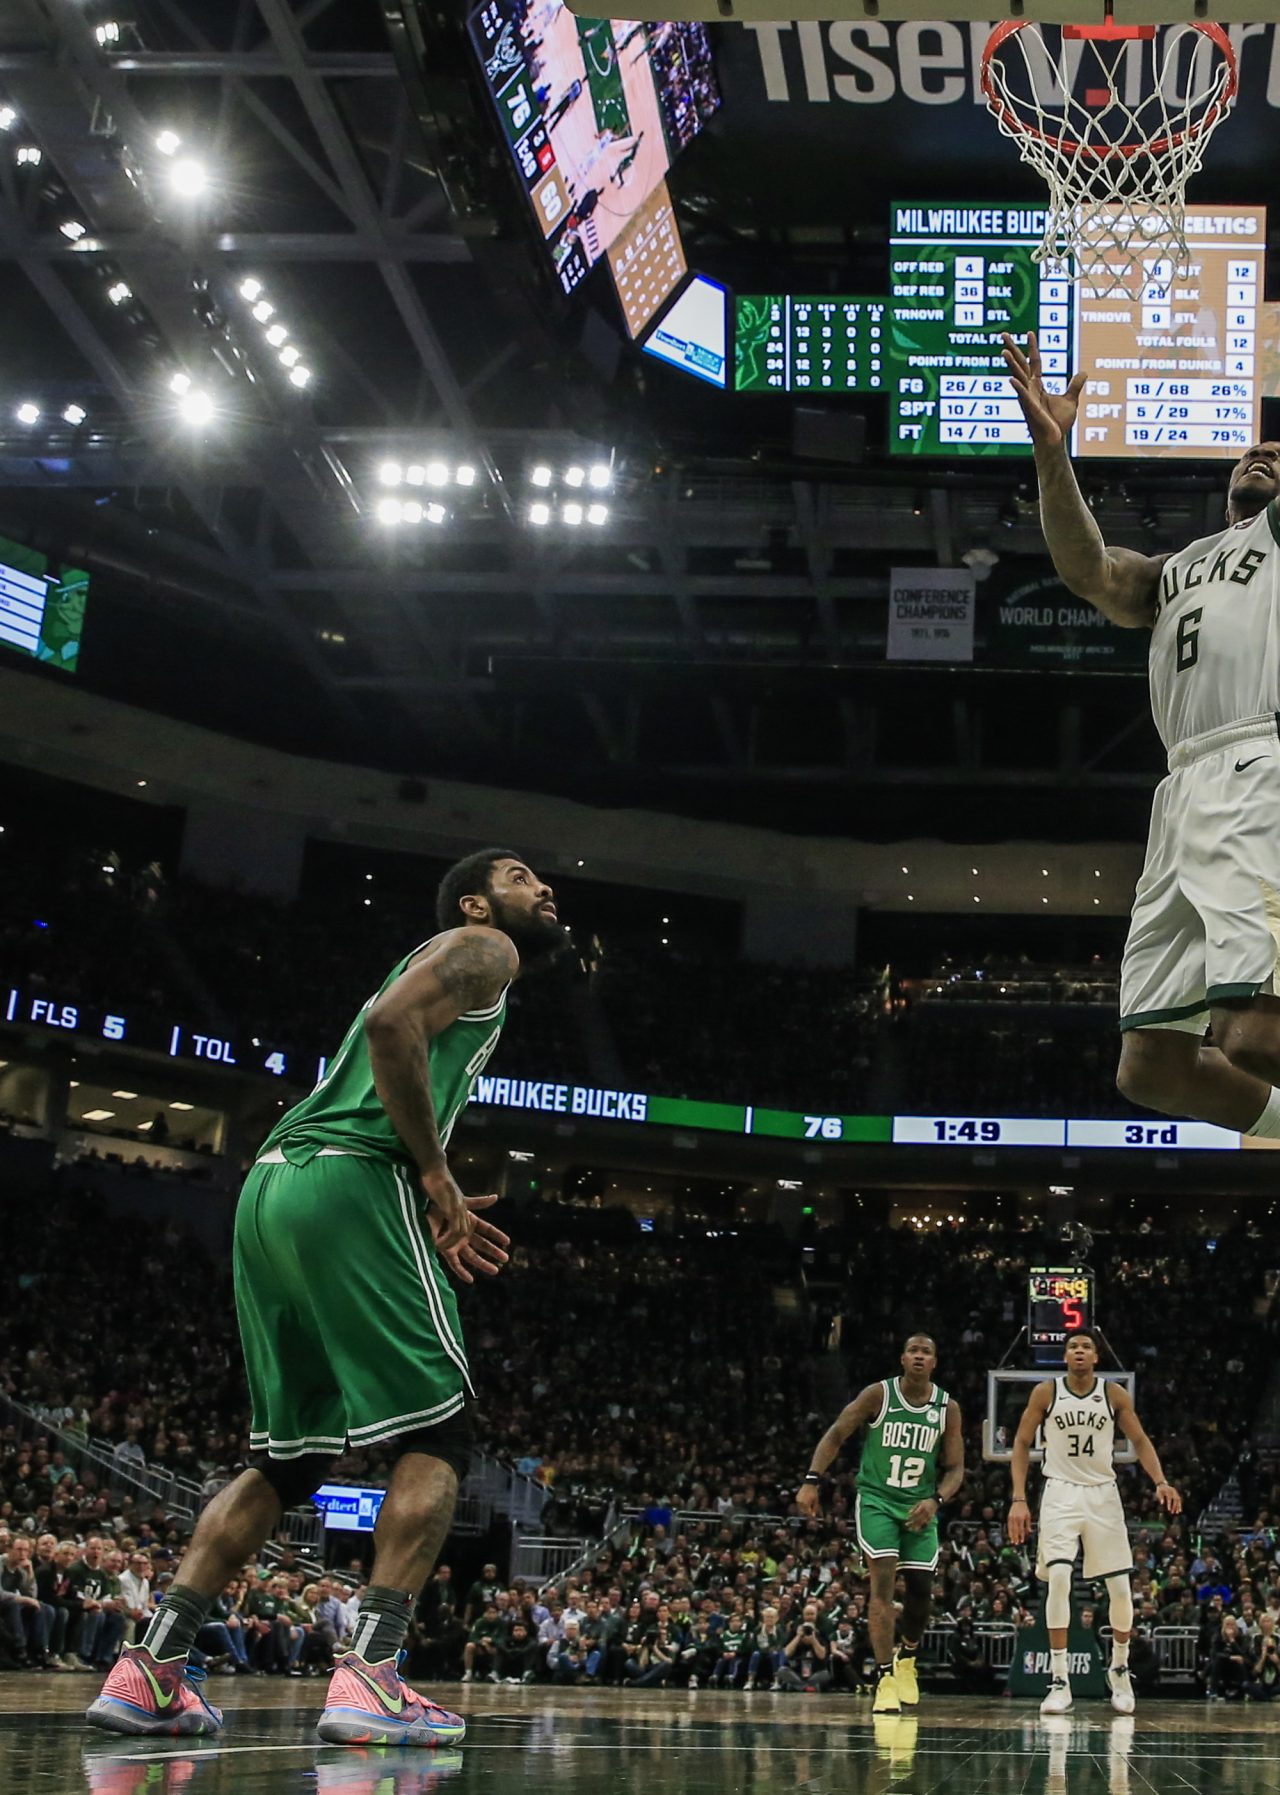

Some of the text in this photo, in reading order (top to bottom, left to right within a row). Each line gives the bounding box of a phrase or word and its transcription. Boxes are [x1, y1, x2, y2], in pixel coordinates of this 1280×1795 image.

[896, 209, 1003, 233] MILWAUKEE
[1184, 216, 1258, 235] CELTICS
[965, 264, 973, 273] 4
[988, 262, 1014, 274] AST
[1235, 267, 1249, 277] 12
[960, 287, 978, 297] 36
[987, 286, 1012, 298] BLK
[1050, 288, 1059, 298] 6
[894, 309, 945, 321] TRNOVR
[963, 311, 975, 320] 11
[987, 310, 1011, 321] STL
[1050, 312, 1059, 322] 6
[1236, 315, 1245, 325] 6
[847, 327, 856, 337] 0
[871, 327, 880, 337] 0
[948, 333, 987, 345] TOTAL
[1046, 334, 1060, 344] 14
[1136, 336, 1217, 348] TOTAL FOULS
[1233, 338, 1248, 348] 12
[822, 343, 831, 353] 7
[871, 343, 880, 353] 0
[822, 359, 831, 370] 7
[908, 355, 954, 367] POINTS
[955, 356, 990, 367] FROM
[1049, 358, 1058, 367] 2
[1095, 358, 1222, 371] POINTS FROM DUNKS
[1235, 361, 1244, 371] 4
[796, 375, 810, 386] 10
[871, 375, 880, 386] 0
[899, 378, 924, 393] FG
[946, 381, 1003, 392] 26 62
[1085, 381, 1111, 396] FG
[1134, 384, 1247, 397] 18 68 26%
[899, 401, 936, 416] 3PT
[947, 405, 1001, 415] 10 31
[1085, 403, 1122, 419] 3PT
[1137, 407, 1247, 420] 5 29 17%
[899, 424, 923, 440] FT
[947, 427, 1001, 438] 14 18
[1084, 427, 1109, 442] FT
[1132, 430, 1246, 442] 19 24 79%
[1155, 549, 1266, 625] UCKS
[894, 589, 970, 604] CONFERENCE
[896, 605, 967, 619] CHAMPIONS
[1000, 607, 1053, 626] WORLD
[1176, 606, 1204, 673] 6
[30, 999, 126, 1041] FLS 5
[192, 1034, 287, 1076] TOL 4
[572, 1088, 648, 1121] BUCKS
[803, 1116, 843, 1139] 76
[933, 1120, 1001, 1142] 1:49
[1124, 1125, 1178, 1145] 3rd
[1063, 1298, 1082, 1329] 5
[1054, 1409, 1108, 1432] BUCKS
[882, 1421, 939, 1454] BOSTON
[1067, 1434, 1095, 1458] 34
[886, 1454, 926, 1488] 12
